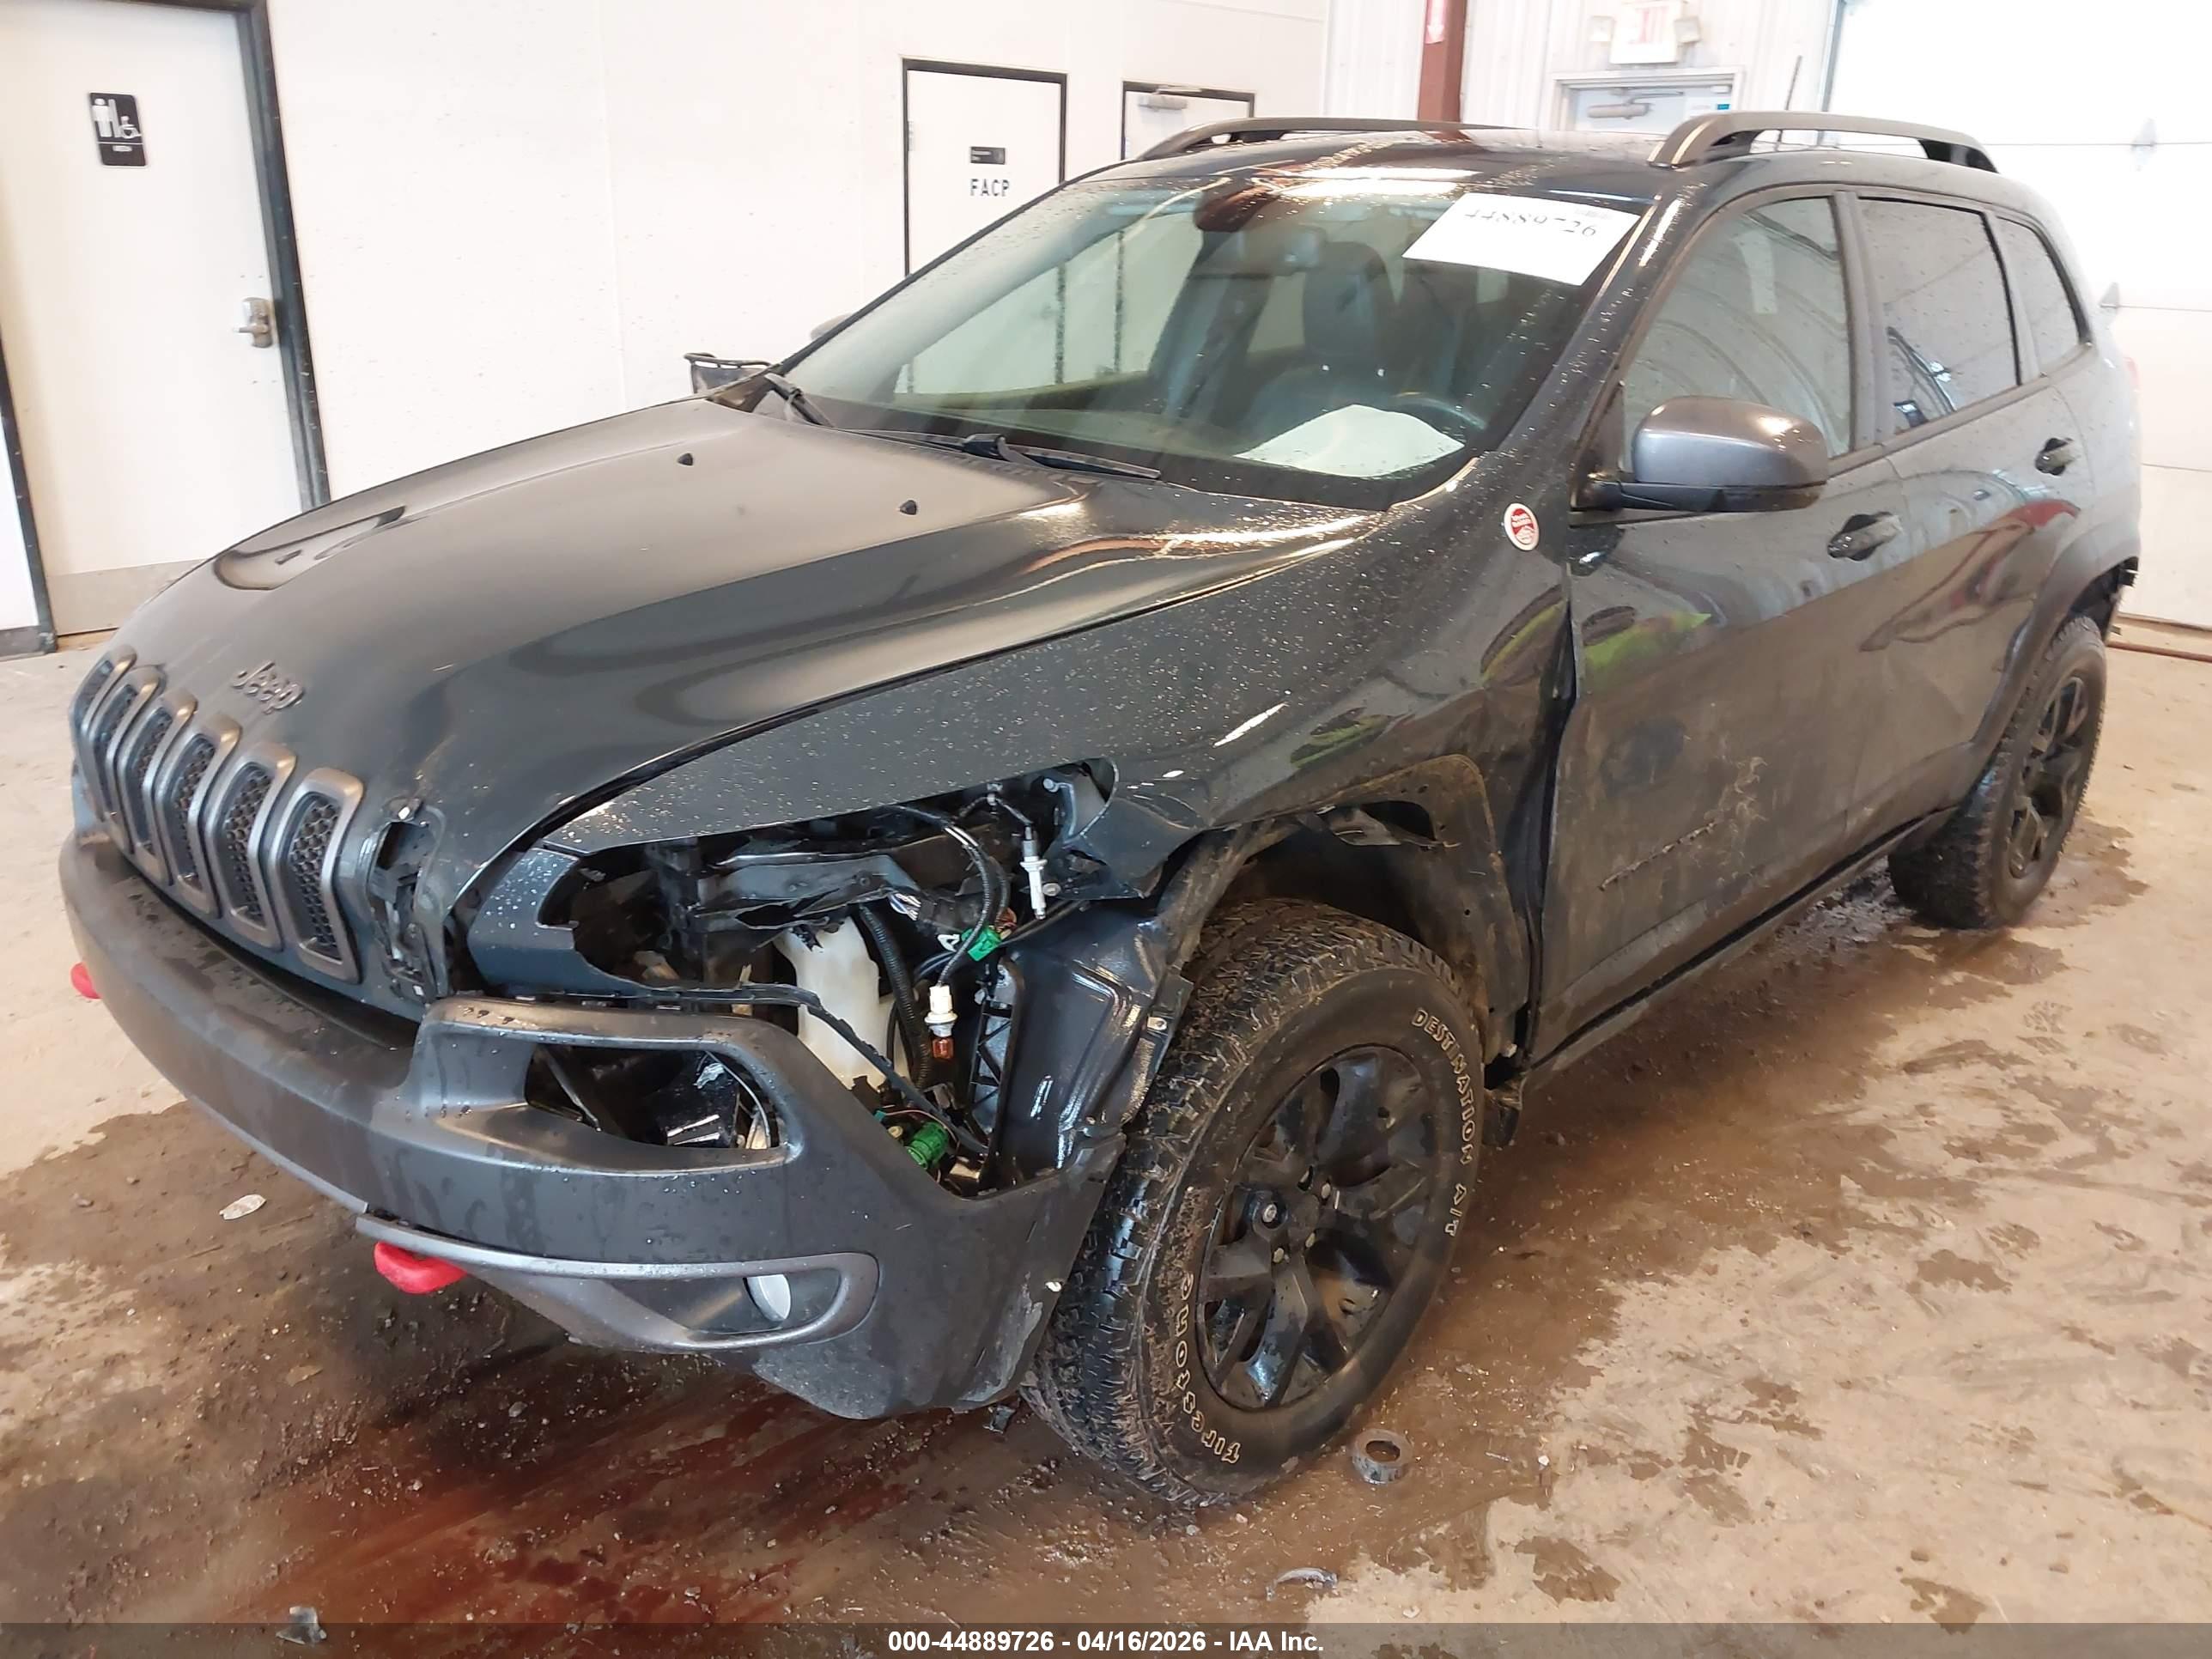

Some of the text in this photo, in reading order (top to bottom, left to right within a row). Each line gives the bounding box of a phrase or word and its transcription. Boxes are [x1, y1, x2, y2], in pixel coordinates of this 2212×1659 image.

[969, 178, 1010, 197] FACP
[230, 661, 305, 715] Jeep
[1411, 1009, 1476, 1165] DESTINATION
